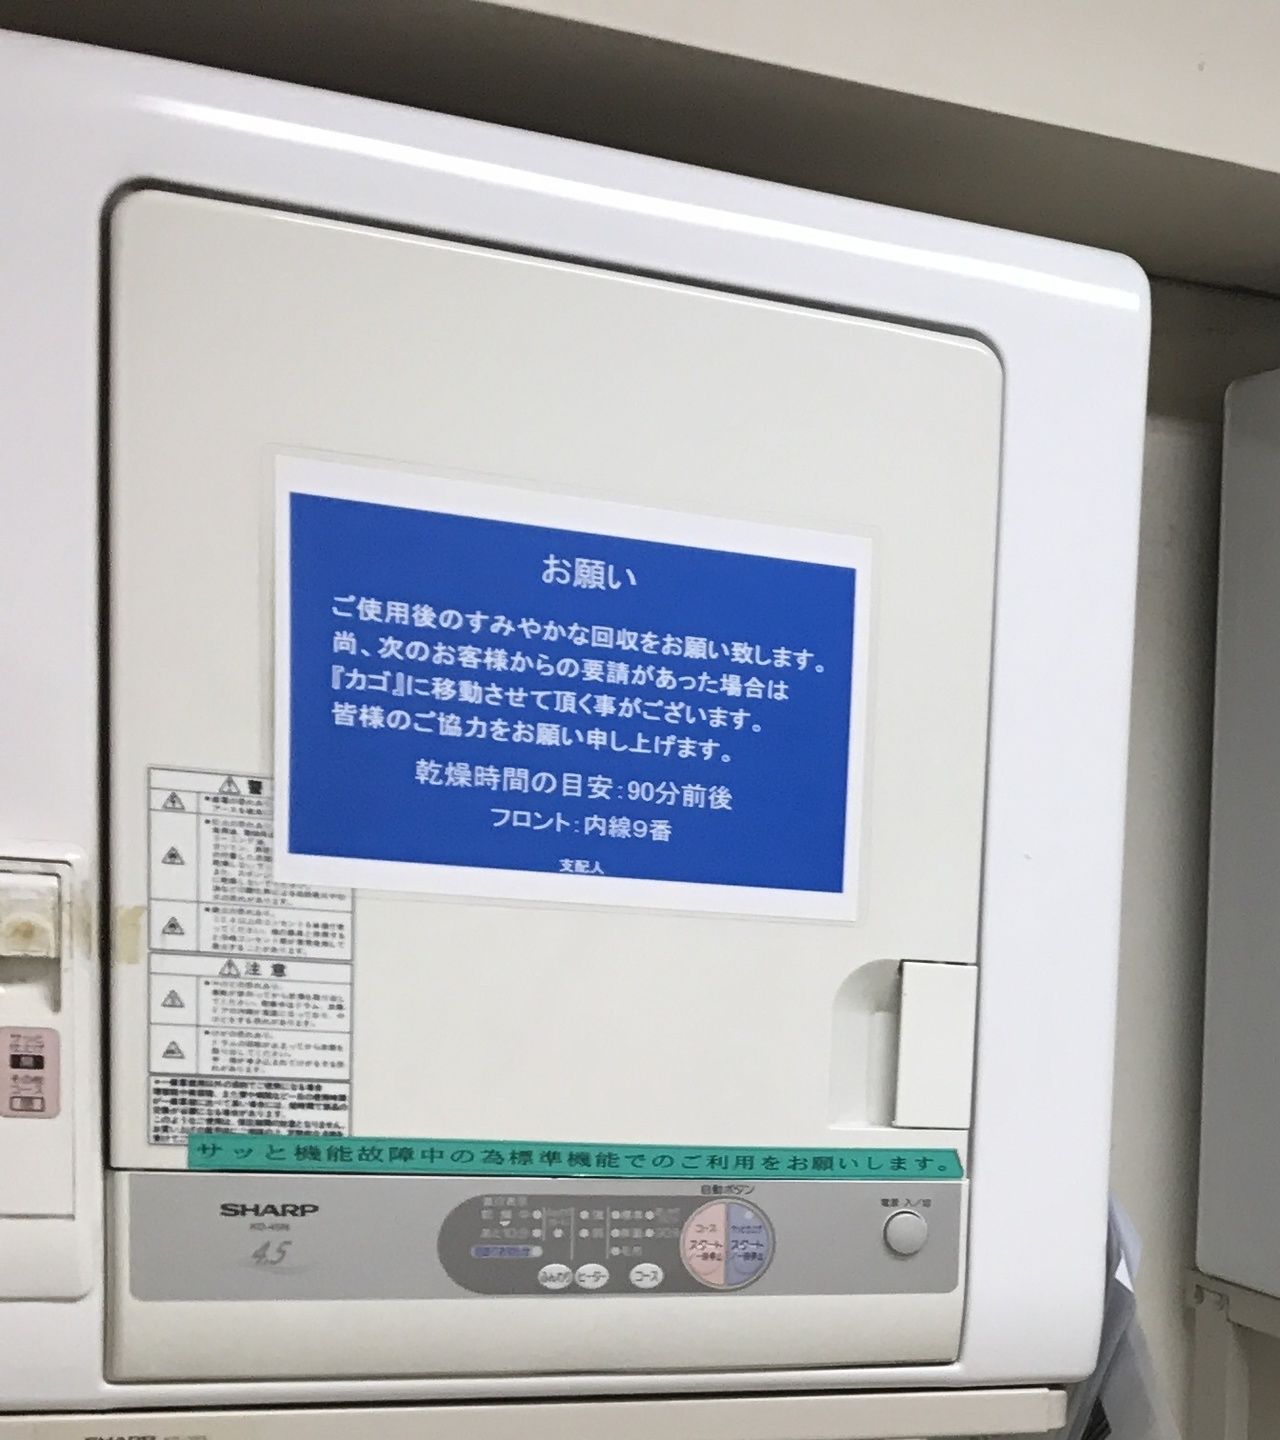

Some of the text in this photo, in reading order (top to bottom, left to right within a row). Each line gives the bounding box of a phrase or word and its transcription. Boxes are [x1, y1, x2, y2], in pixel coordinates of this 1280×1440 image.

[542, 555, 637, 590] お願い
[331, 595, 826, 674] ご使用後のすみやかな回収をお願い致します。
[332, 630, 789, 701] 尚、次のお客様からの要請があった場合は
[331, 665, 763, 733] 『カゴ』に移動させて頂く事がございます。
[331, 702, 731, 765] 皆様のご協力をお願い申し上げます。
[559, 859, 605, 875] 支配人
[245, 961, 287, 977] 注意
[196, 1143, 948, 1172] サッと機能故障中の為標準機能でのご利用をお願いします。
[220, 1203, 319, 1217] SHARP
[689, 1239, 723, 1250] スタート
[731, 1239, 764, 1250] スタート
